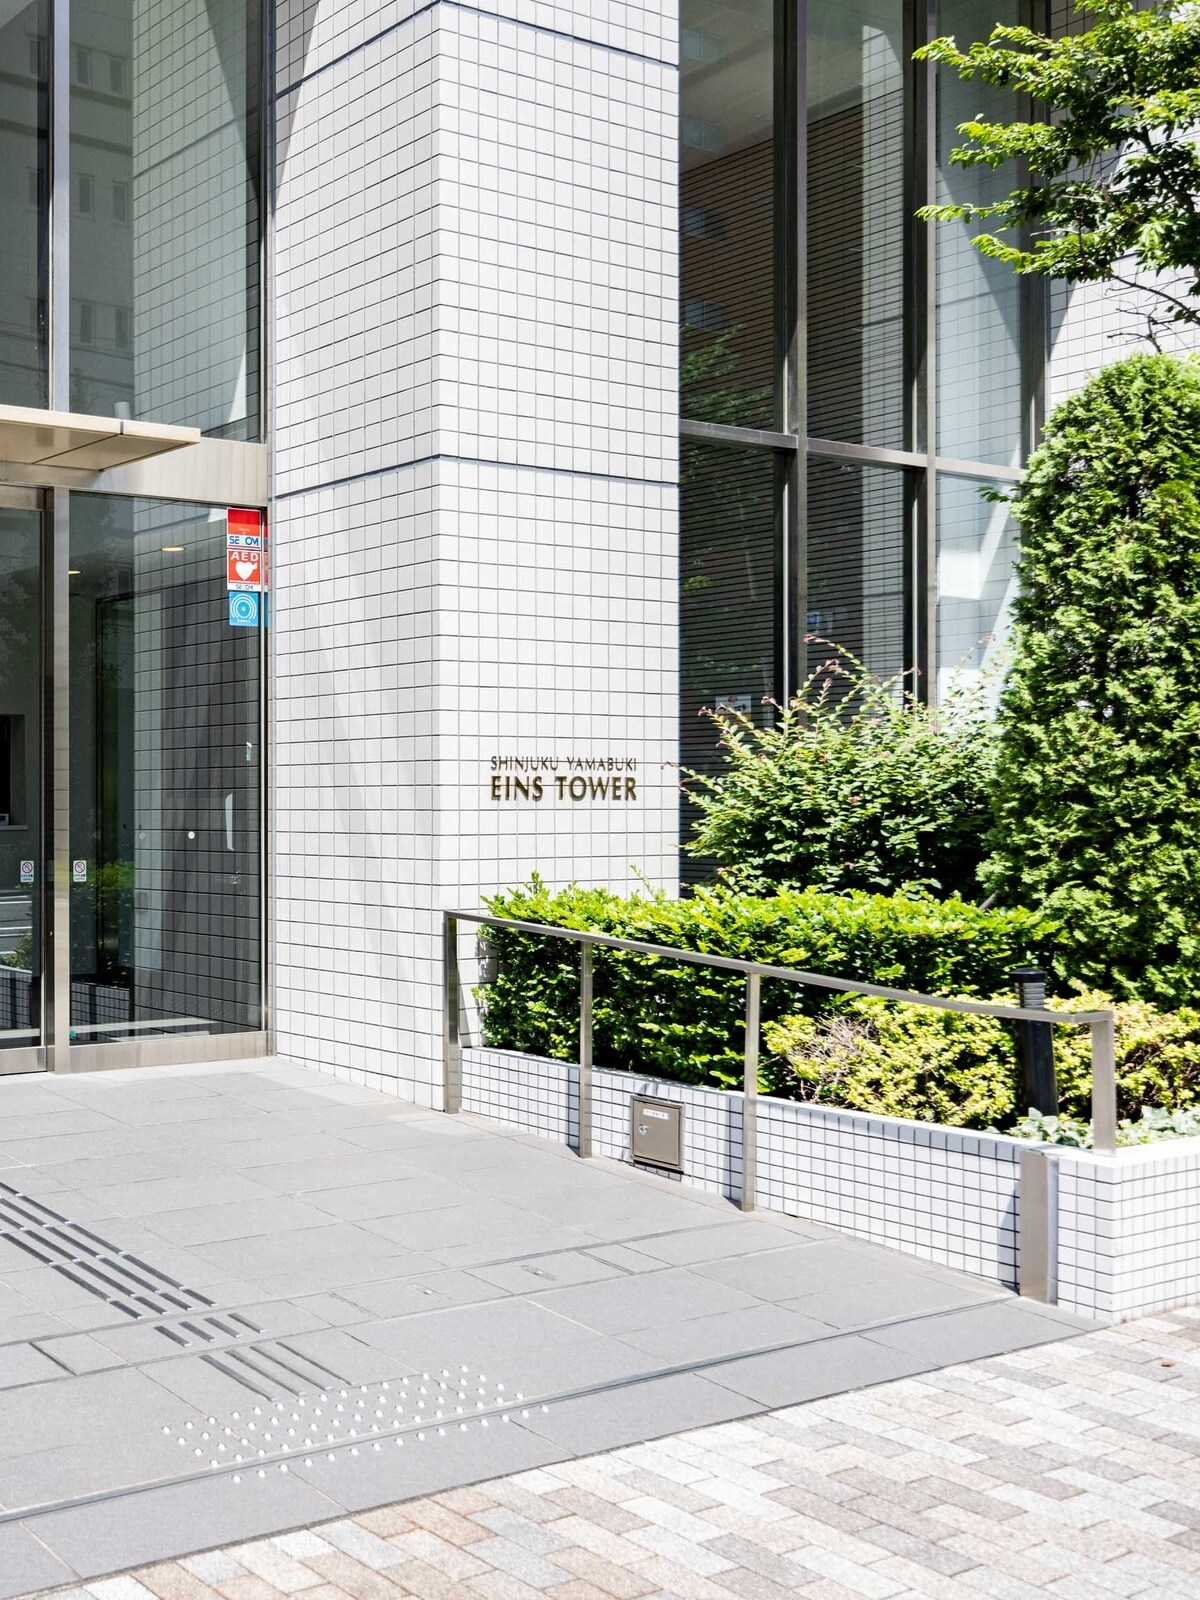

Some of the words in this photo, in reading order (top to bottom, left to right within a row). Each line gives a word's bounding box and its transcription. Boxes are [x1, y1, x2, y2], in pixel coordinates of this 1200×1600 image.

[229, 535, 259, 546] SEOM
[230, 551, 259, 562] AED
[490, 755, 559, 773] SHINJUKU
[566, 756, 637, 772] YAMABUKI
[490, 775, 543, 802] EINS
[554, 776, 637, 802] TOWER
